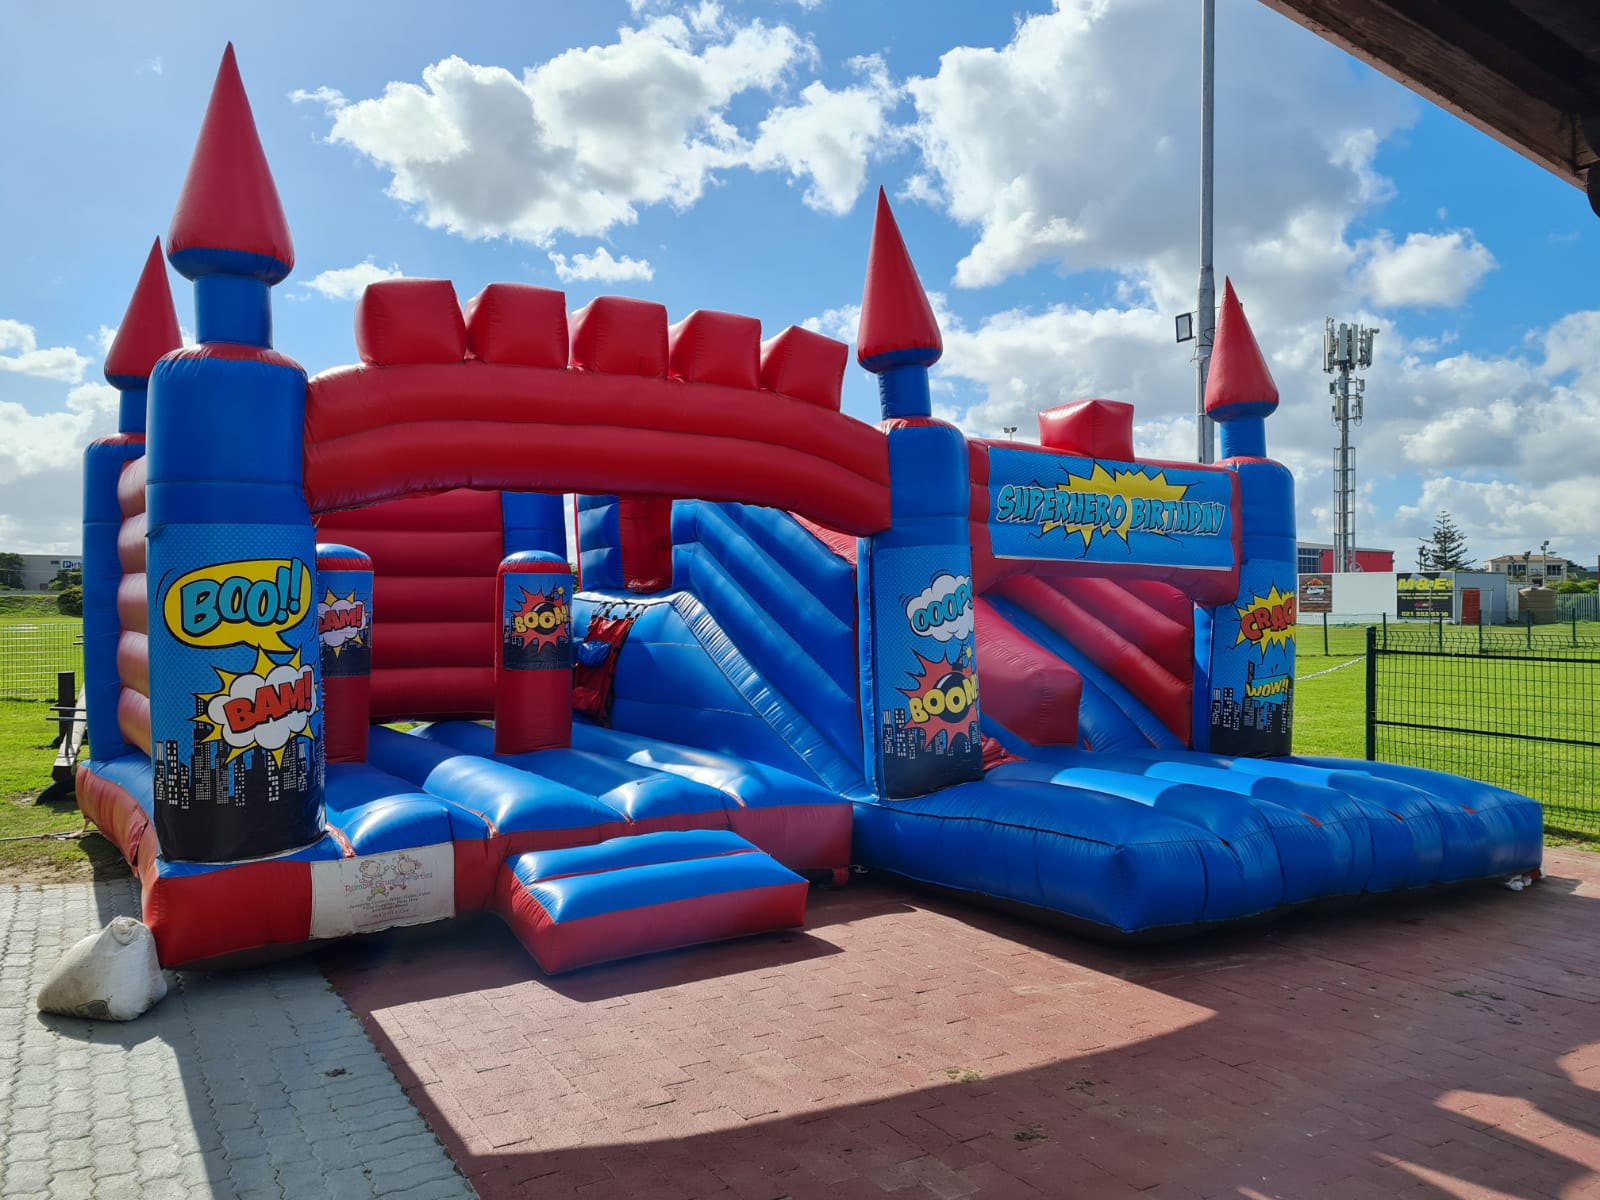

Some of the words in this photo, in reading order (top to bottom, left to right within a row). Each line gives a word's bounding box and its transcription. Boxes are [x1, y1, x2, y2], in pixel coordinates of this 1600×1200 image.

[996, 484, 1128, 529] SUPERHERO
[1129, 497, 1226, 535] BIRTHDAY
[180, 556, 303, 637] BOO!!
[223, 671, 313, 734] BAM!
